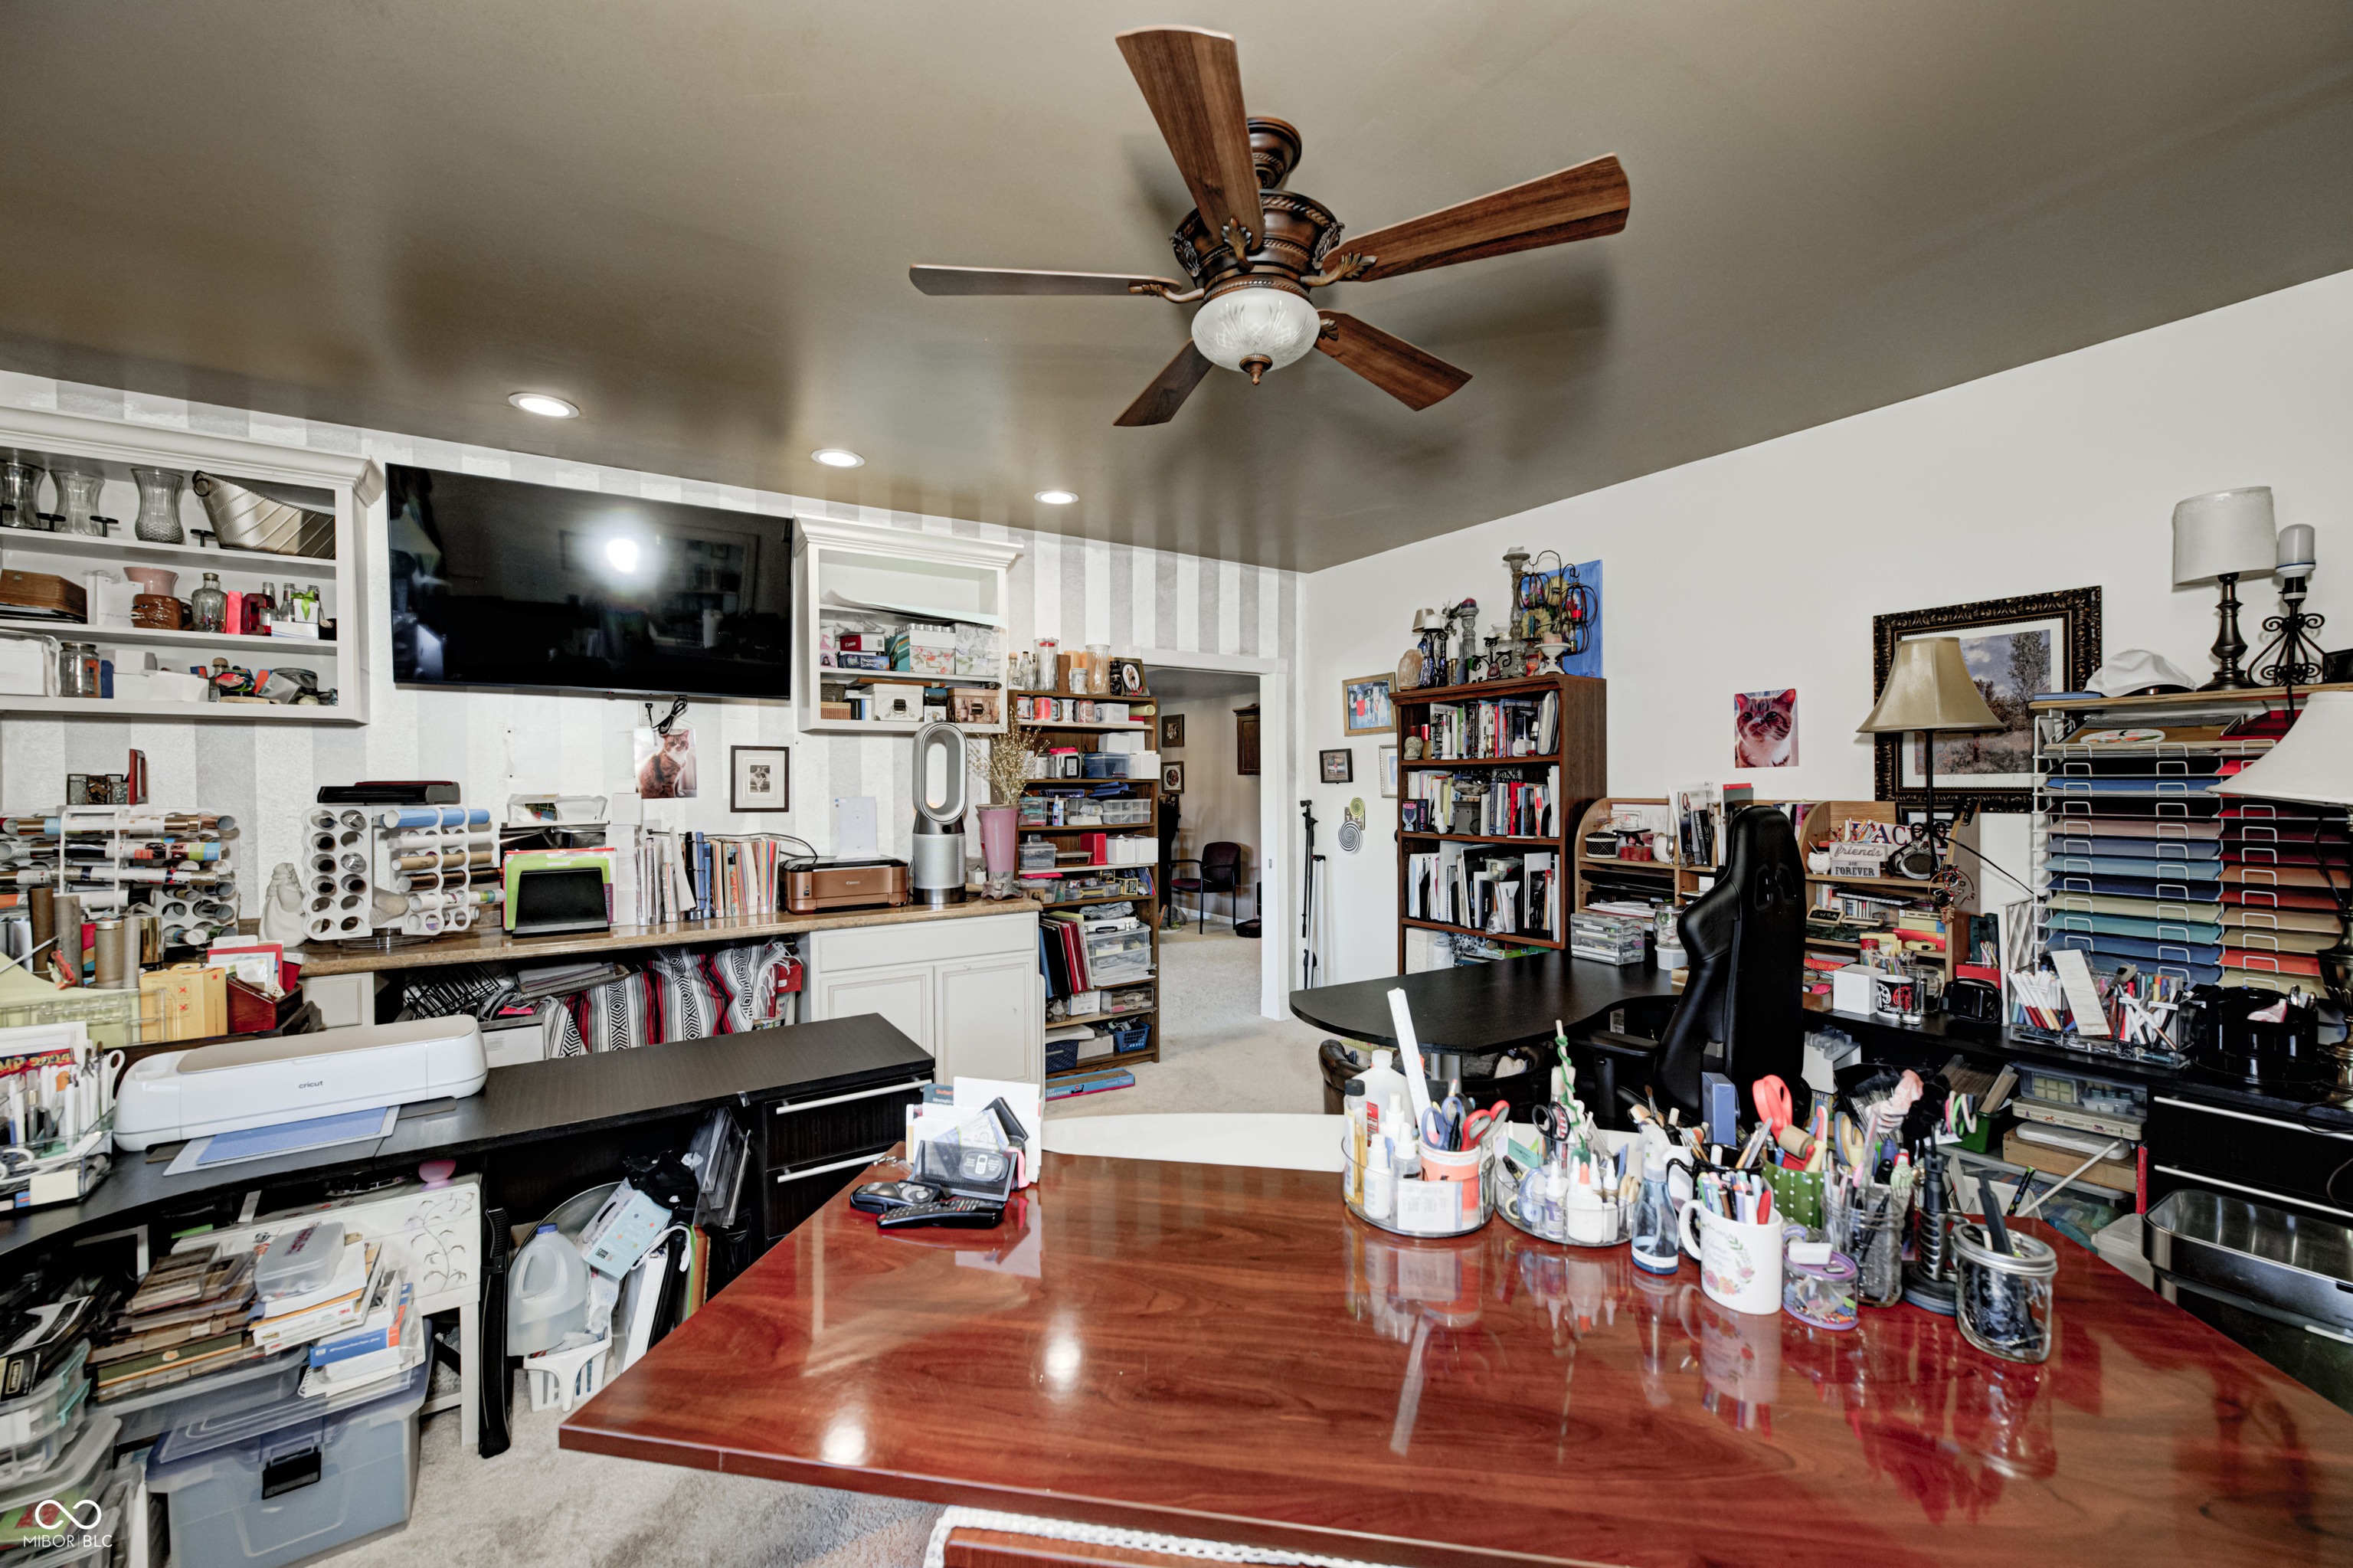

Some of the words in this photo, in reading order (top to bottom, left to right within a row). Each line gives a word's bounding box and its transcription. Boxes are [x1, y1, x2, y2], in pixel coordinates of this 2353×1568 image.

[1834, 845, 1883, 857] friends
[1834, 866, 1875, 876] FOREVER
[29, 1052, 70, 1068] 2024
